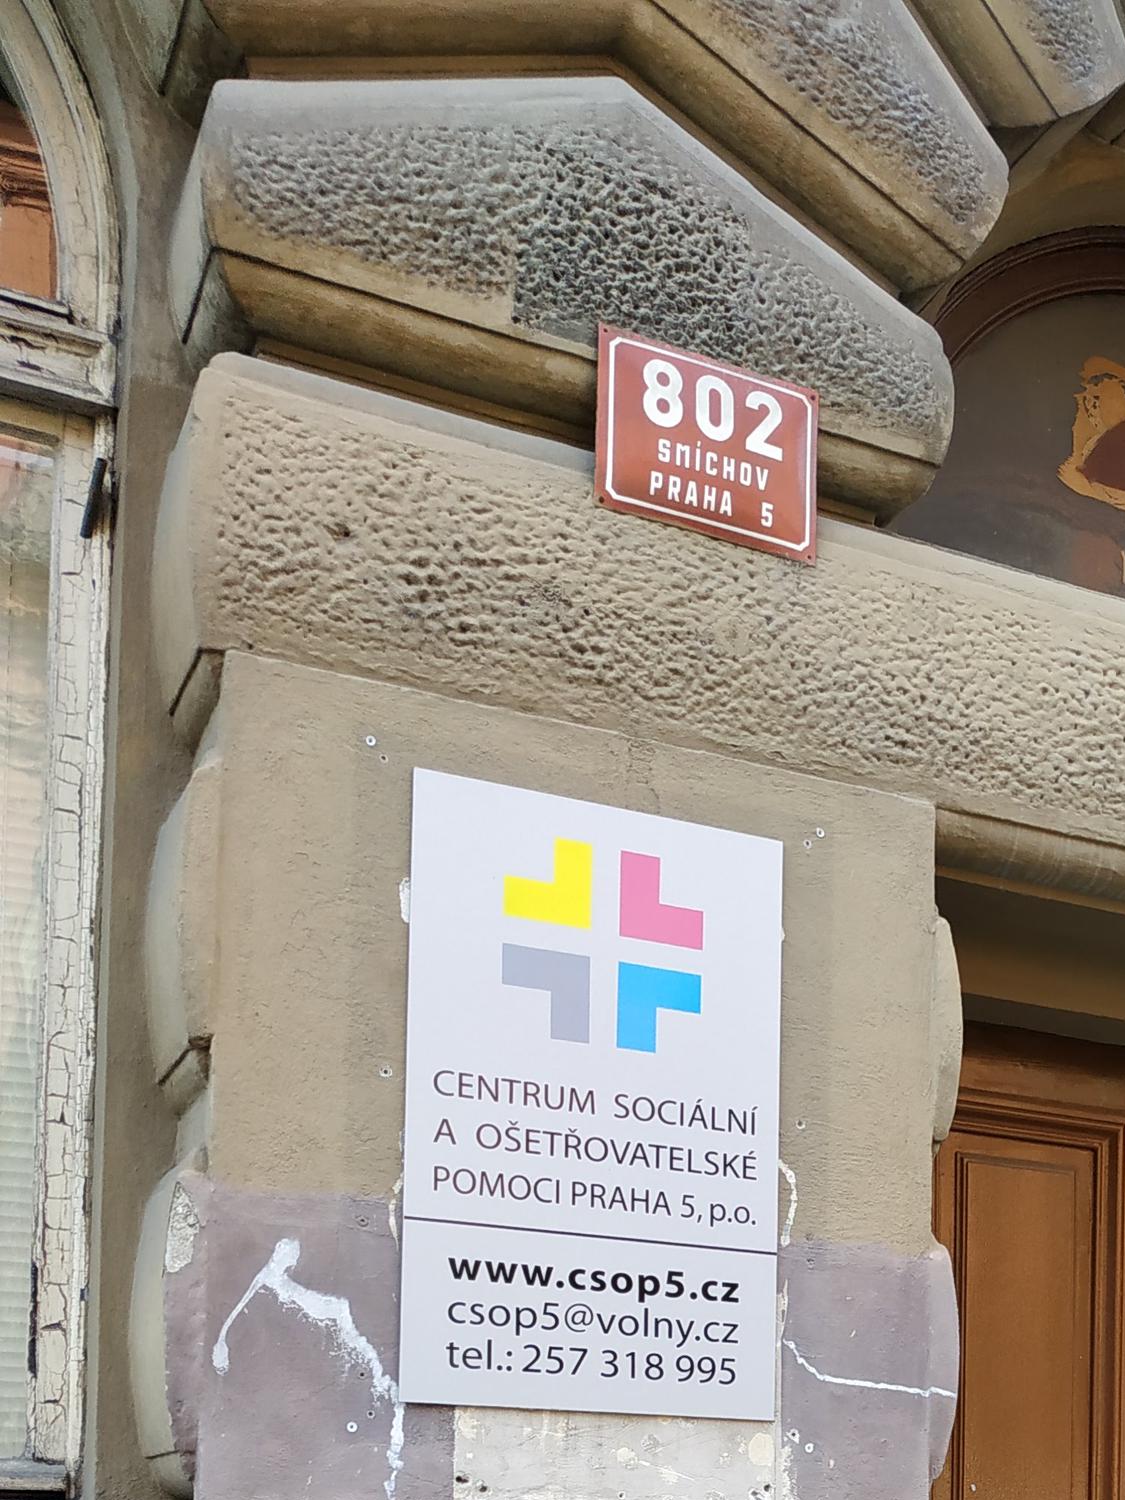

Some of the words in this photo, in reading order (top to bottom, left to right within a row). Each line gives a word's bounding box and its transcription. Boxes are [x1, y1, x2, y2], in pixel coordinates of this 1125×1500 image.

[643, 359, 783, 462] 802
[658, 438, 769, 490] SMÍCHOV
[650, 470, 733, 516] PRAHA
[761, 502, 774, 528] 5
[432, 1069, 597, 1115] CENTRUM
[613, 1093, 760, 1136] SOCIÁLNÍ
[433, 1118, 457, 1145] A
[475, 1120, 758, 1181] OŠETŘOVATELSKÉ
[433, 1165, 561, 1204] POMOCI
[571, 1181, 672, 1216] PRAHA
[680, 1195, 702, 1223] 5,
[709, 1202, 758, 1227] p.o.
[448, 1256, 740, 1304] www.csop5.cz
[447, 1301, 740, 1348] csop5@volny.cz
[445, 1340, 513, 1372] tel.:
[521, 1344, 589, 1376] 257
[600, 1349, 664, 1381] 318
[675, 1355, 737, 1386] 995
